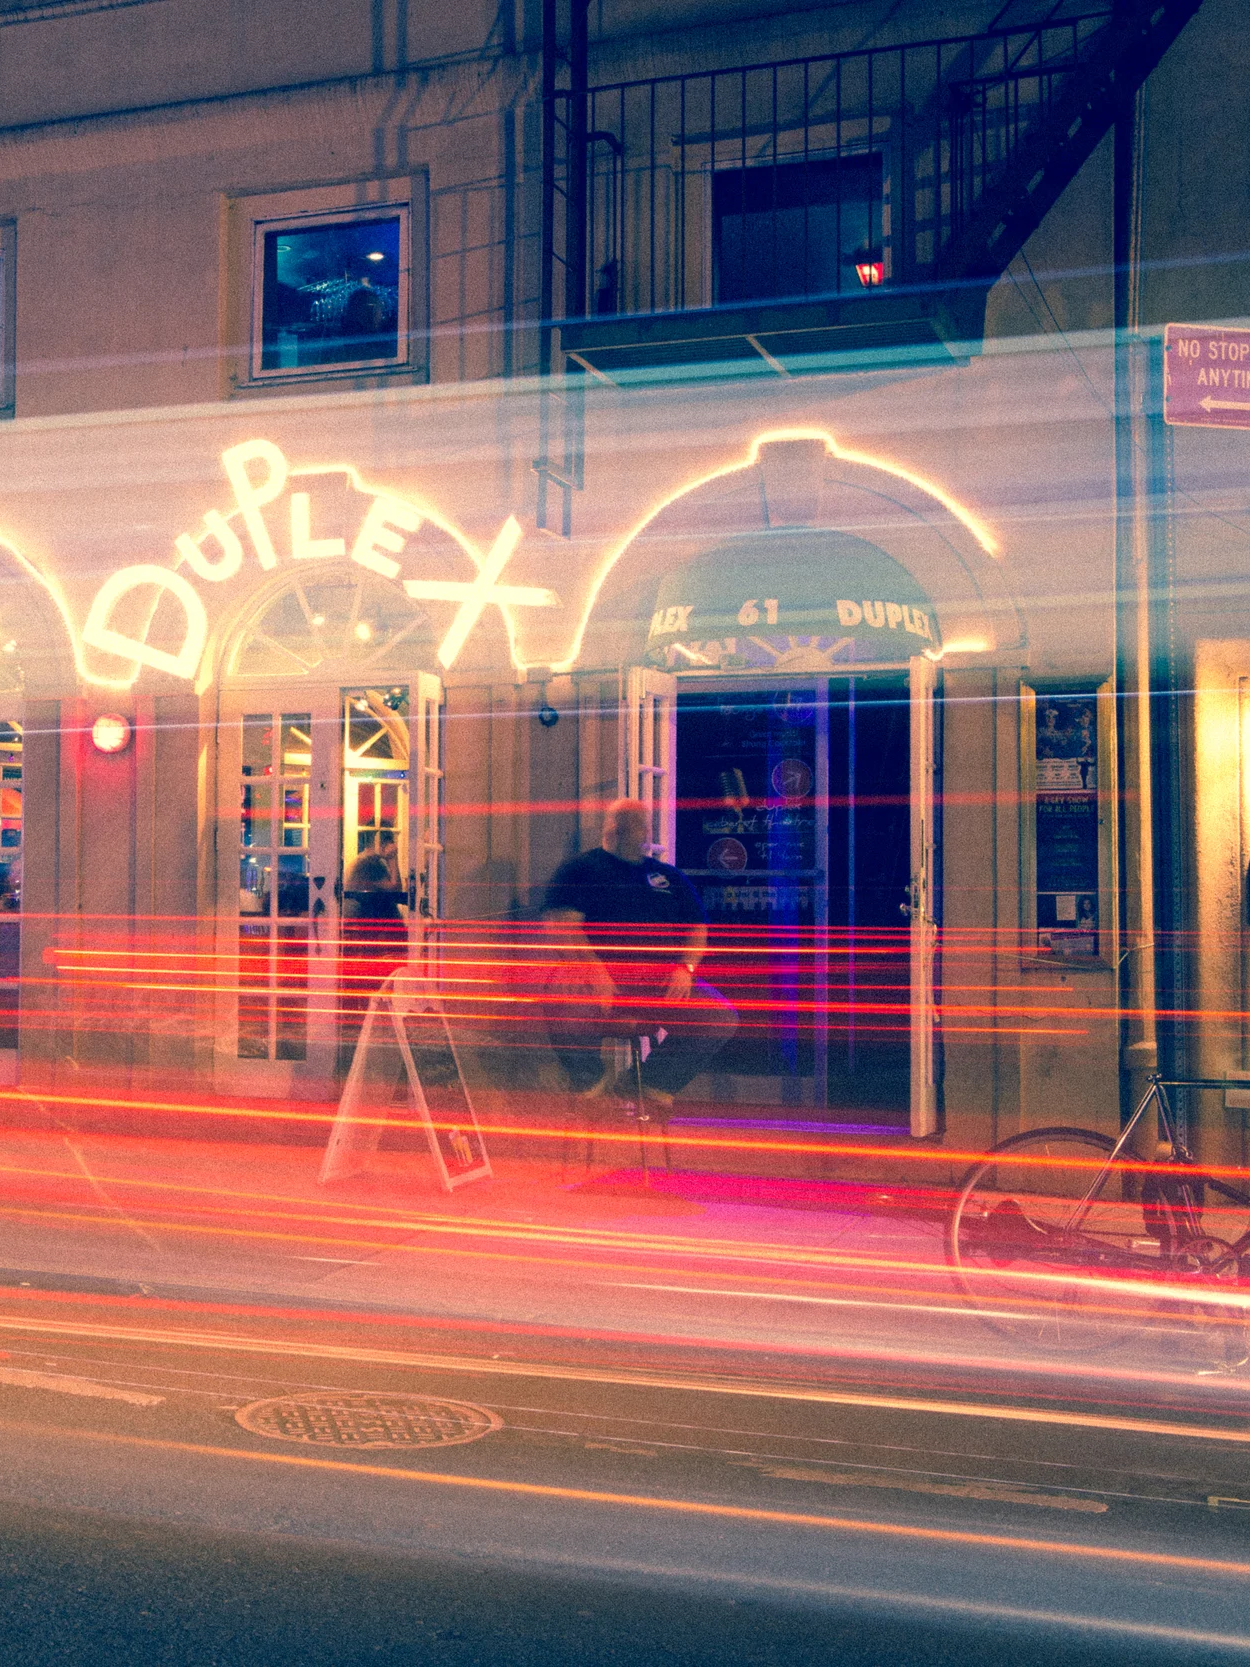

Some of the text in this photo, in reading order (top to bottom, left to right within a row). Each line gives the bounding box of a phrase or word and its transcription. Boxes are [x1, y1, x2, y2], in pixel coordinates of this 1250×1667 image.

[1178, 338, 1200, 358] NO
[82, 438, 560, 681] DUPLEX
[738, 599, 779, 627] 61
